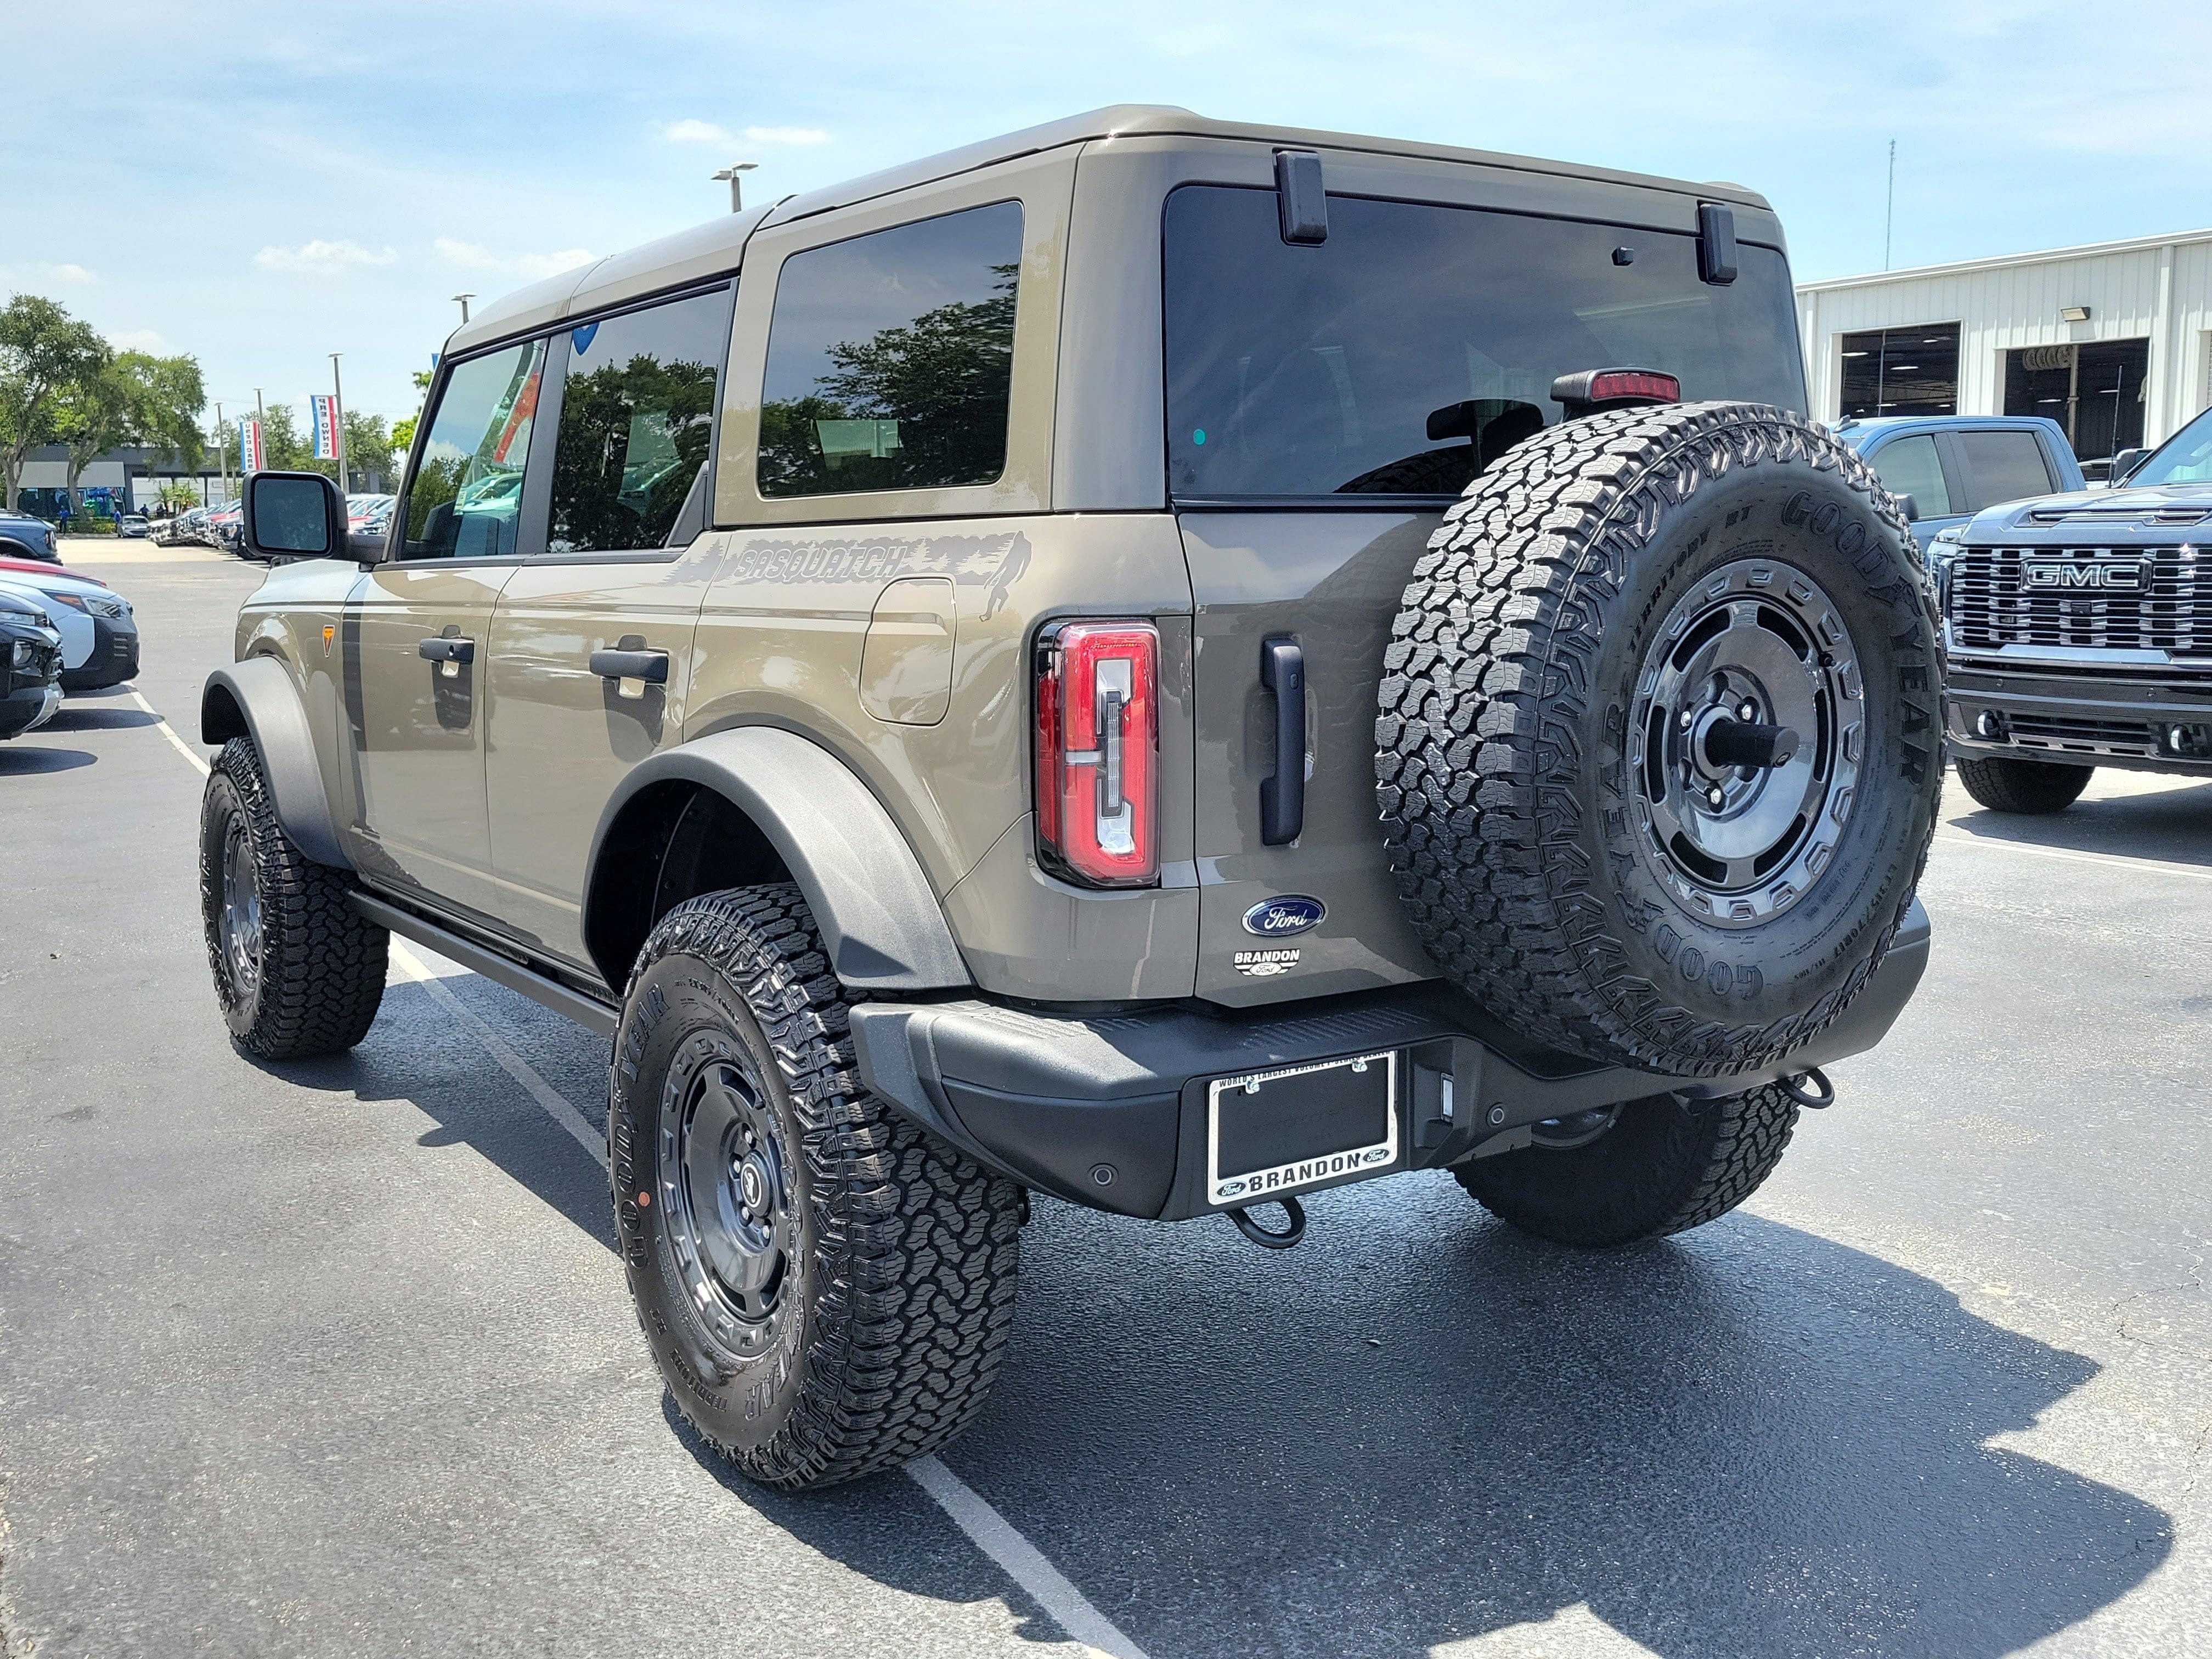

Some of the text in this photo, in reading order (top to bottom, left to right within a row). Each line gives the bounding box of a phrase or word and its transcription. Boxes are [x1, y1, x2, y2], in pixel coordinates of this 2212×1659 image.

[732, 546, 907, 582] SASQUATCH
[2028, 565, 2140, 588] GMC
[1782, 490, 1931, 786] GOODYEAR
[1264, 906, 1308, 930] Ford
[1234, 949, 1300, 964] BRANDON
[1256, 964, 1275, 973] Ford
[1221, 1183, 1242, 1195] Ford
[1249, 1153, 1361, 1193] BRANDON
